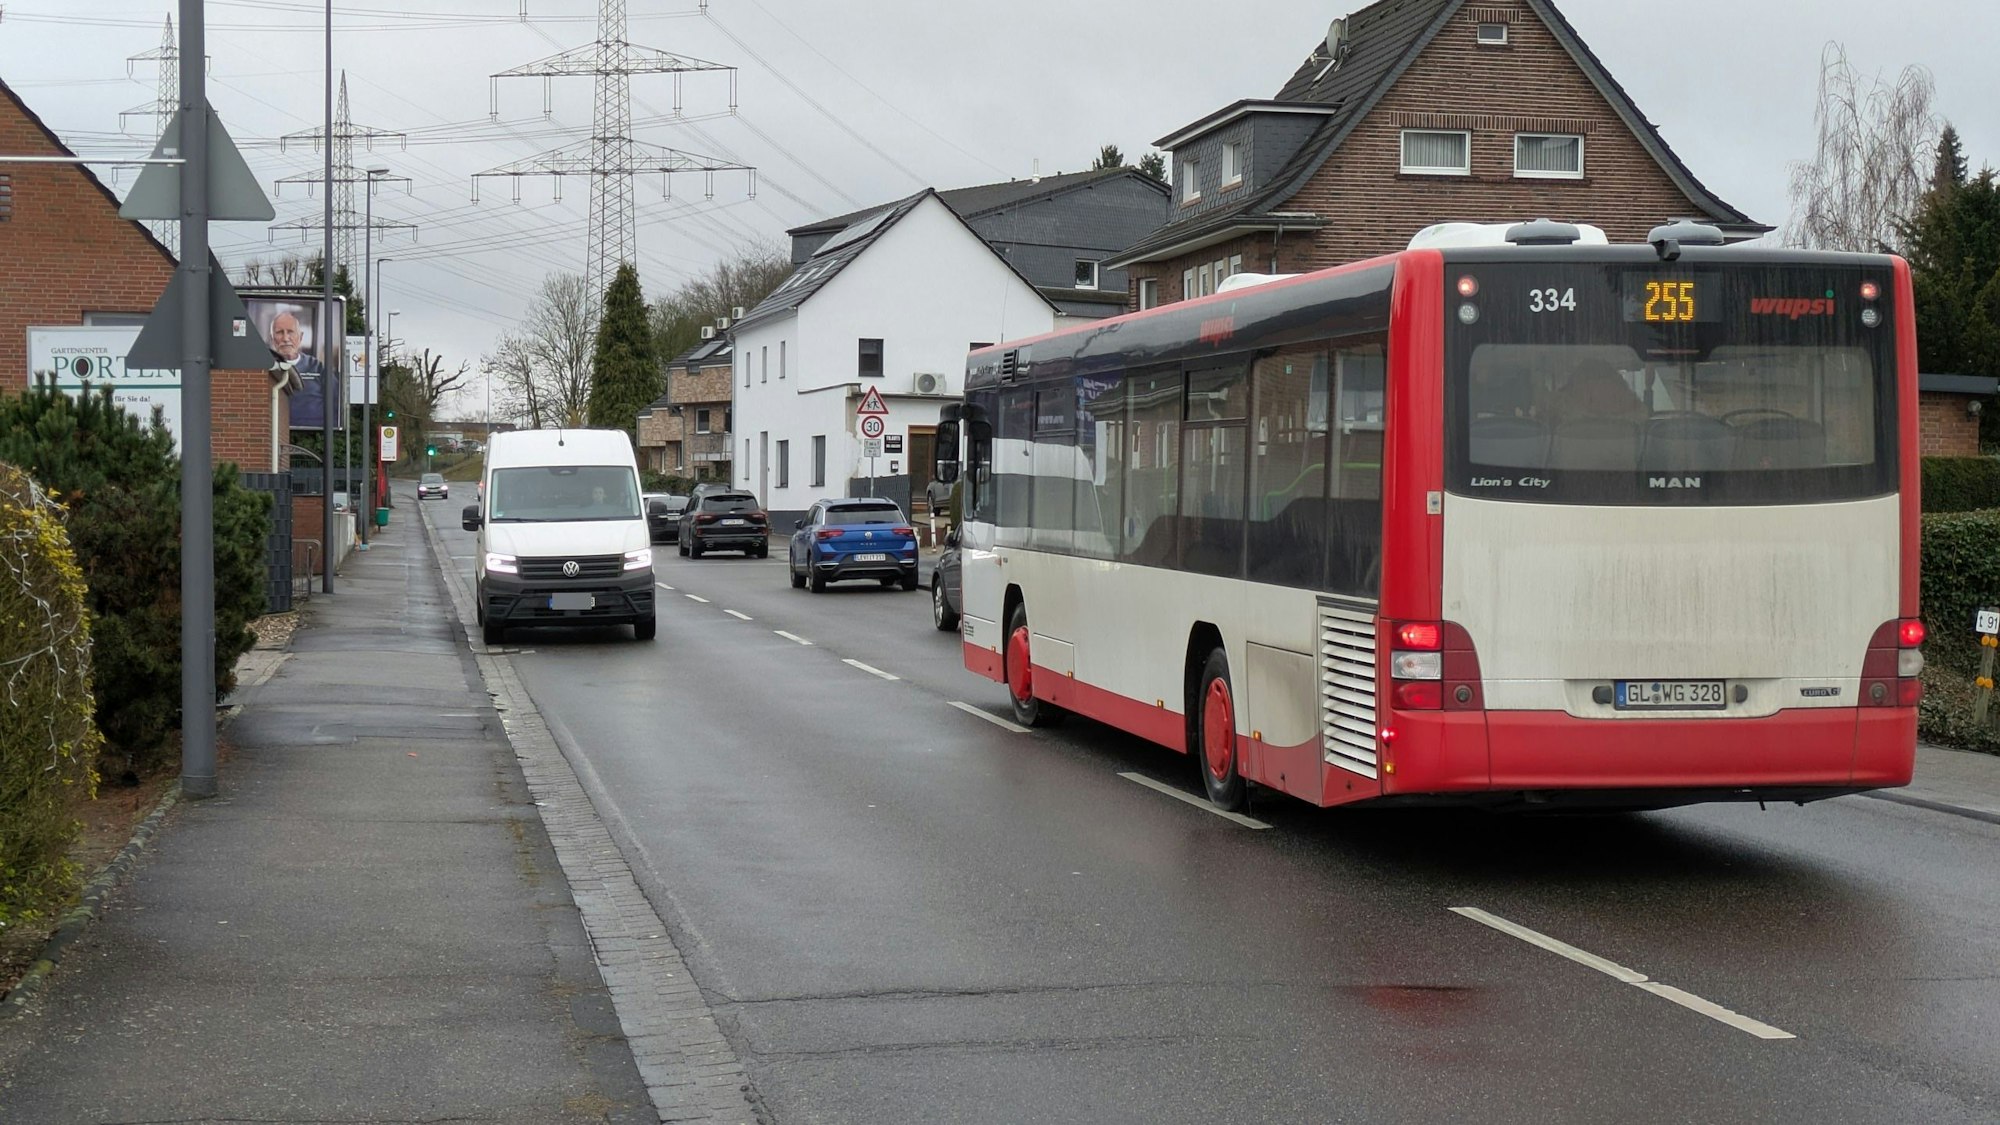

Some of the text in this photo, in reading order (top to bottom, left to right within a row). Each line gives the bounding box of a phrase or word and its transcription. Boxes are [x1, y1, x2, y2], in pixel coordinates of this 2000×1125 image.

[1529, 287, 1577, 313] 334
[1645, 282, 1694, 321] 255
[1750, 289, 1835, 320] wupsi
[866, 421, 880, 432] 30
[1470, 476, 1551, 489] Lion's City
[1648, 476, 1702, 489] MAN
[1987, 616, 1998, 630] 91
[1628, 683, 1722, 702] GL WG 328
